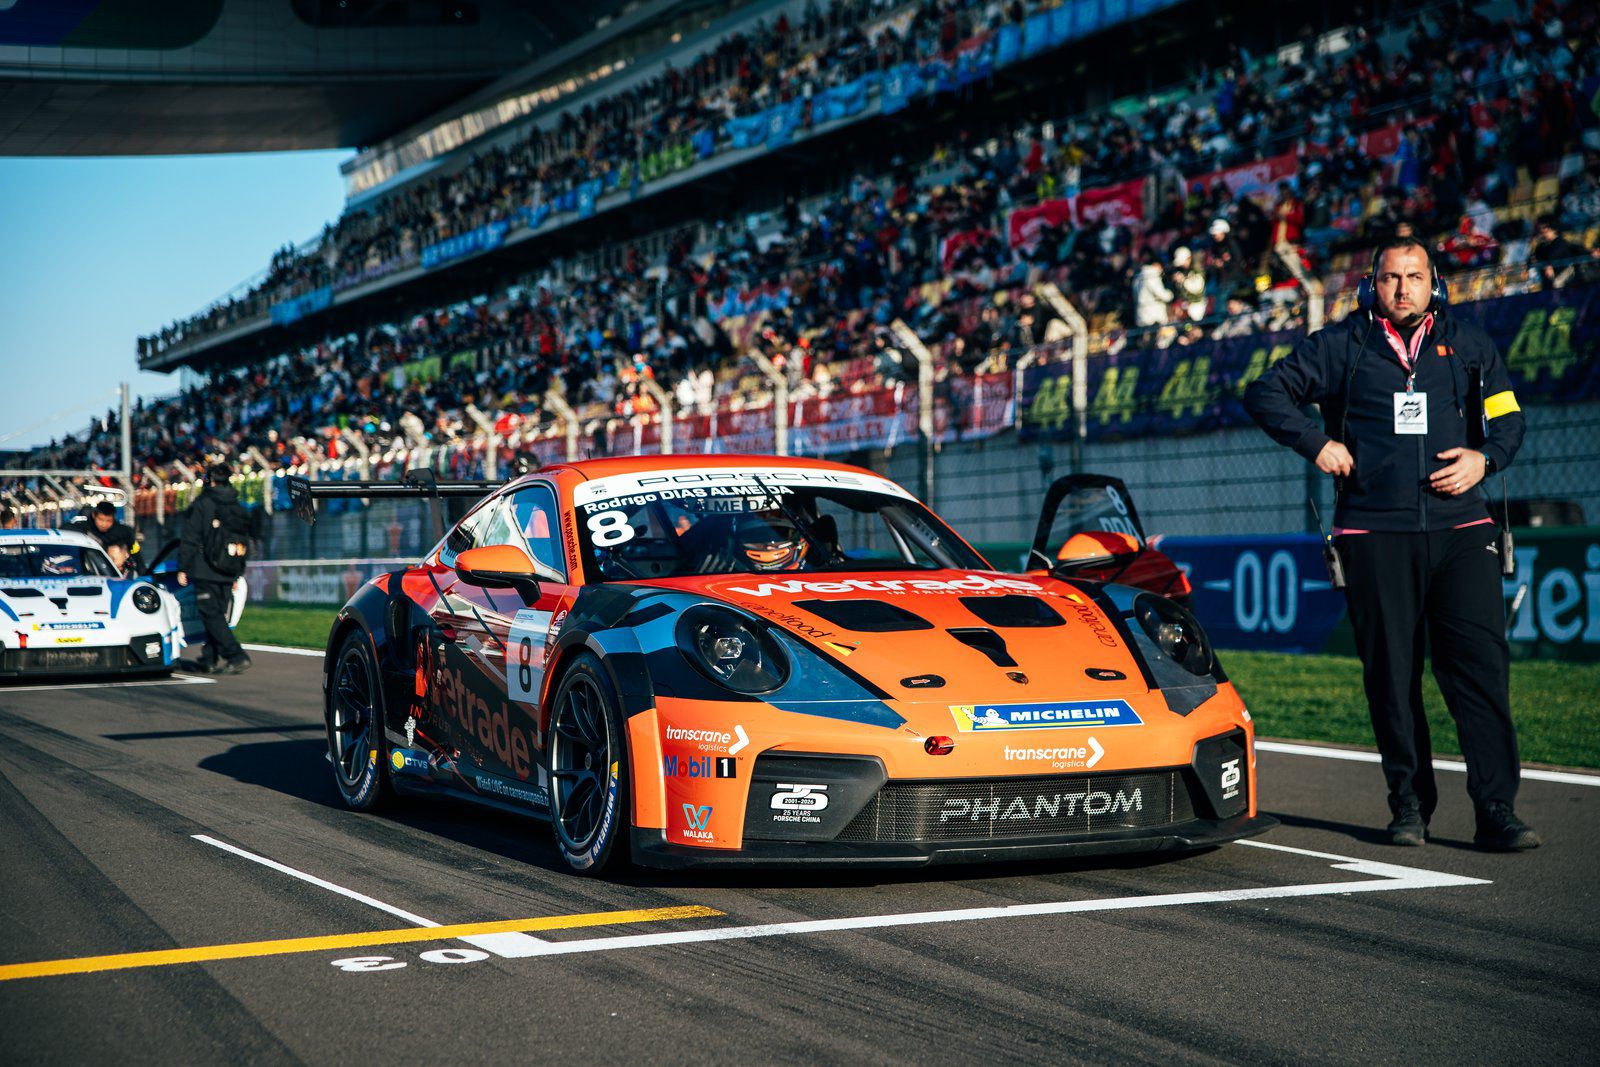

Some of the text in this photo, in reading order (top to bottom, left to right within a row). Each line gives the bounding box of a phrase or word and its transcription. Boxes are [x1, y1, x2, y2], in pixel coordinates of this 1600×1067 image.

[637, 472, 863, 488] PORSCHE
[583, 485, 795, 515] Rodrigo DIAS ALMEIDA
[1105, 484, 1128, 516] 8
[587, 510, 635, 547] 8
[727, 574, 1044, 597] Wetrade
[1234, 549, 1298, 634] 0.0
[518, 636, 532, 693] 8
[1010, 706, 1121, 722] MICHELIN
[666, 725, 731, 744] transcrane
[698, 742, 727, 753] logistics
[1003, 745, 1087, 761] transcrane
[663, 754, 730, 778] Mobil 1
[1052, 759, 1086, 769] logistics
[939, 788, 1144, 823] PHANTOM
[773, 815, 801, 823] PORSCHE
[683, 829, 714, 840] WALAKA
